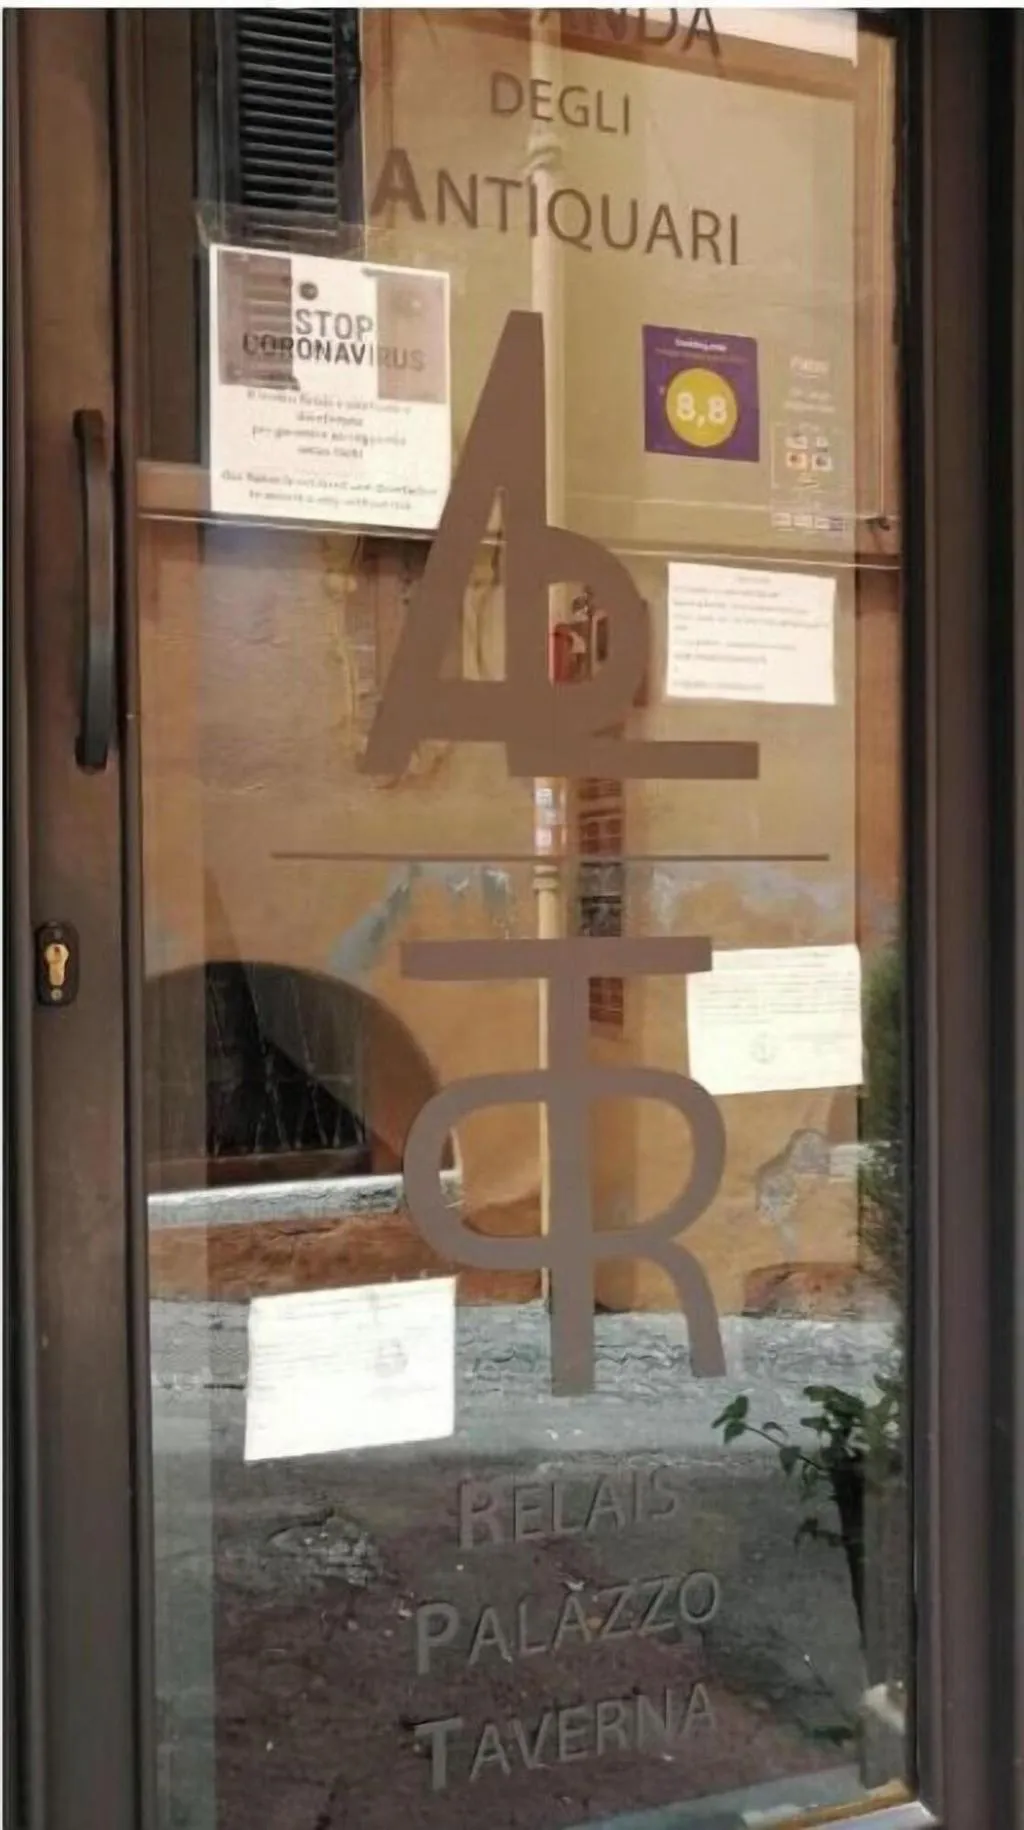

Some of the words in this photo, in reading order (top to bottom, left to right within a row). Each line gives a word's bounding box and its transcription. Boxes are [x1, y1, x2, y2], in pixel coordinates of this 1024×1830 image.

[489, 71, 631, 135] DEGLI
[369, 147, 740, 267] ANTIQUARI
[242, 331, 426, 373] CORONAVIRUS
[294, 308, 374, 342] STOP
[675, 391, 728, 428] 8,8
[457, 1464, 680, 1549] RELAIS
[415, 1569, 722, 1675] PALAZZO
[413, 1682, 718, 1790] TAVERNA
